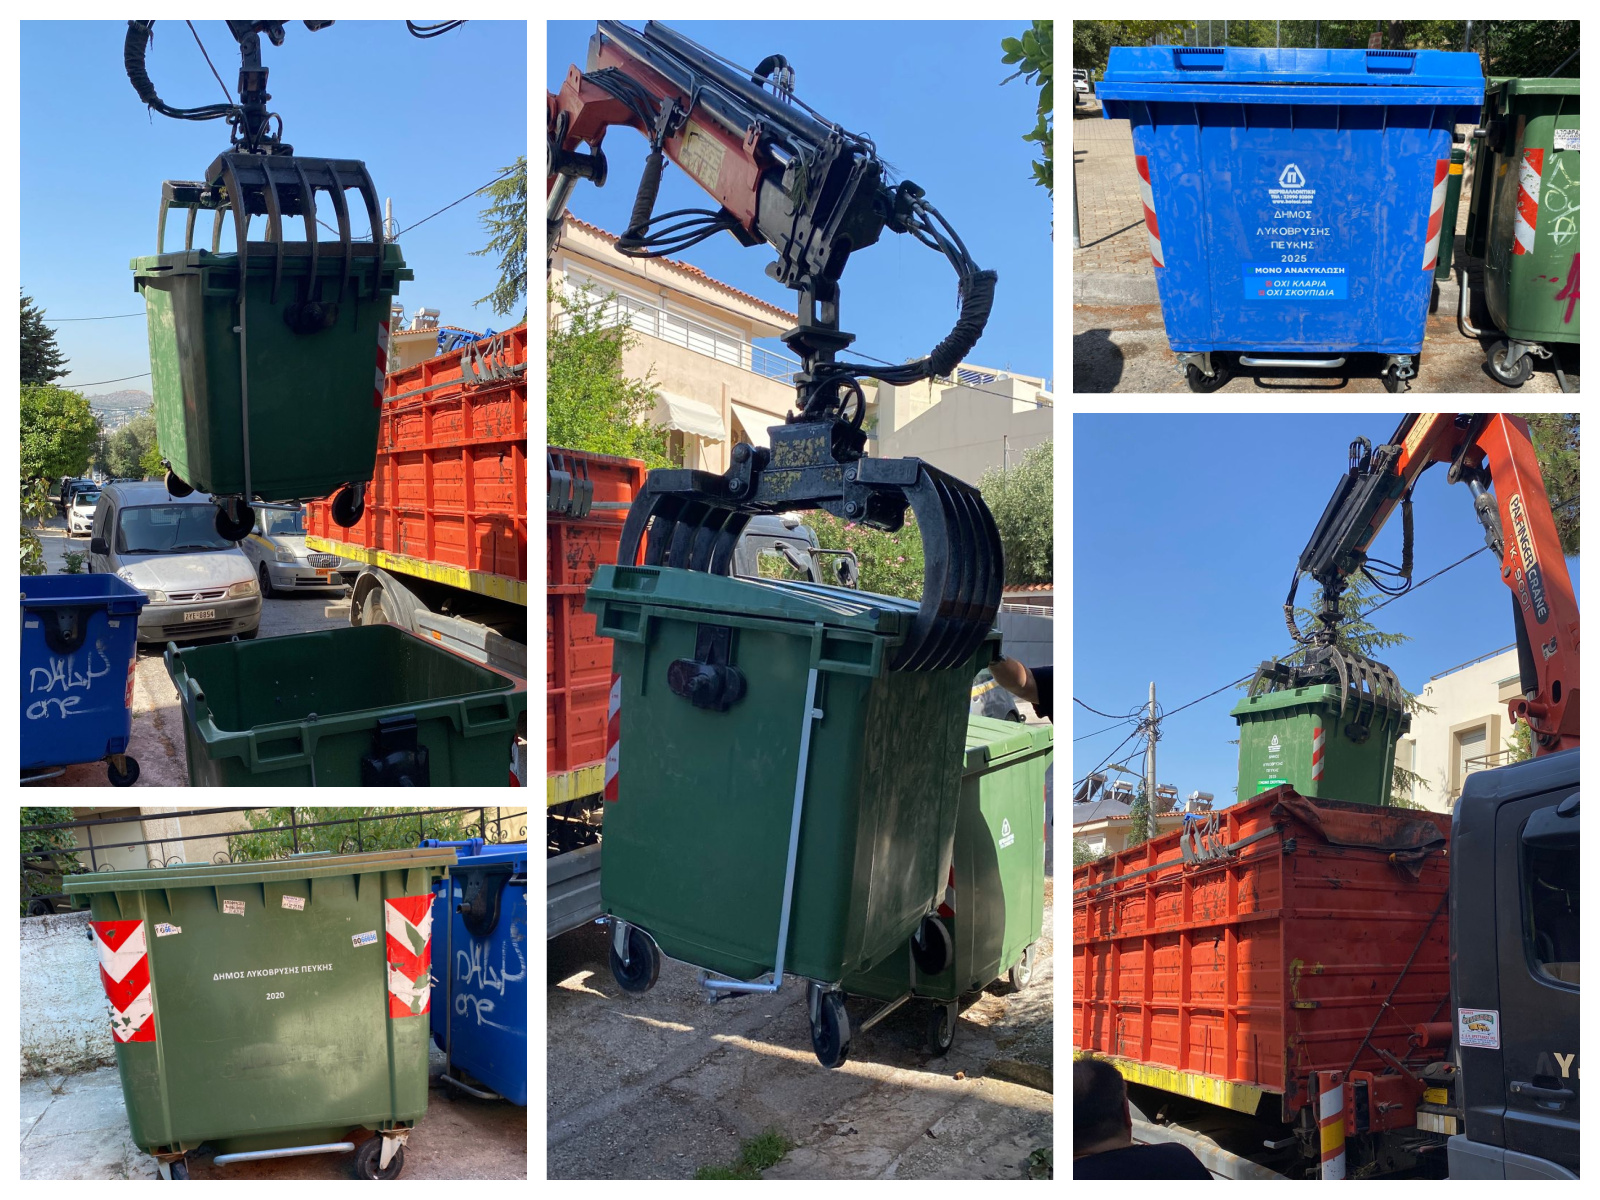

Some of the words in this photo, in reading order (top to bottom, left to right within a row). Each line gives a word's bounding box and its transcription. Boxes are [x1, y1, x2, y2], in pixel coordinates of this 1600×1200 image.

[1274, 210, 1313, 219] ΔΗΜΟΣ
[1256, 227, 1331, 236] ΛΥΚΟΒΡΥΣΗΣ
[1271, 241, 1315, 249] ΠΕΥΚΗΣ
[1281, 254, 1307, 263] 2025
[1511, 496, 1534, 569] PALFINGER
[1528, 568, 1547, 618] CRANE
[213, 971, 245, 981] ΔΗΜΟΣ
[246, 966, 299, 978] ΛΥΚΟΒΡΥΣΗΣ
[301, 963, 333, 973] ΠΕΥΚΗΣ
[265, 991, 285, 1000] 2020
